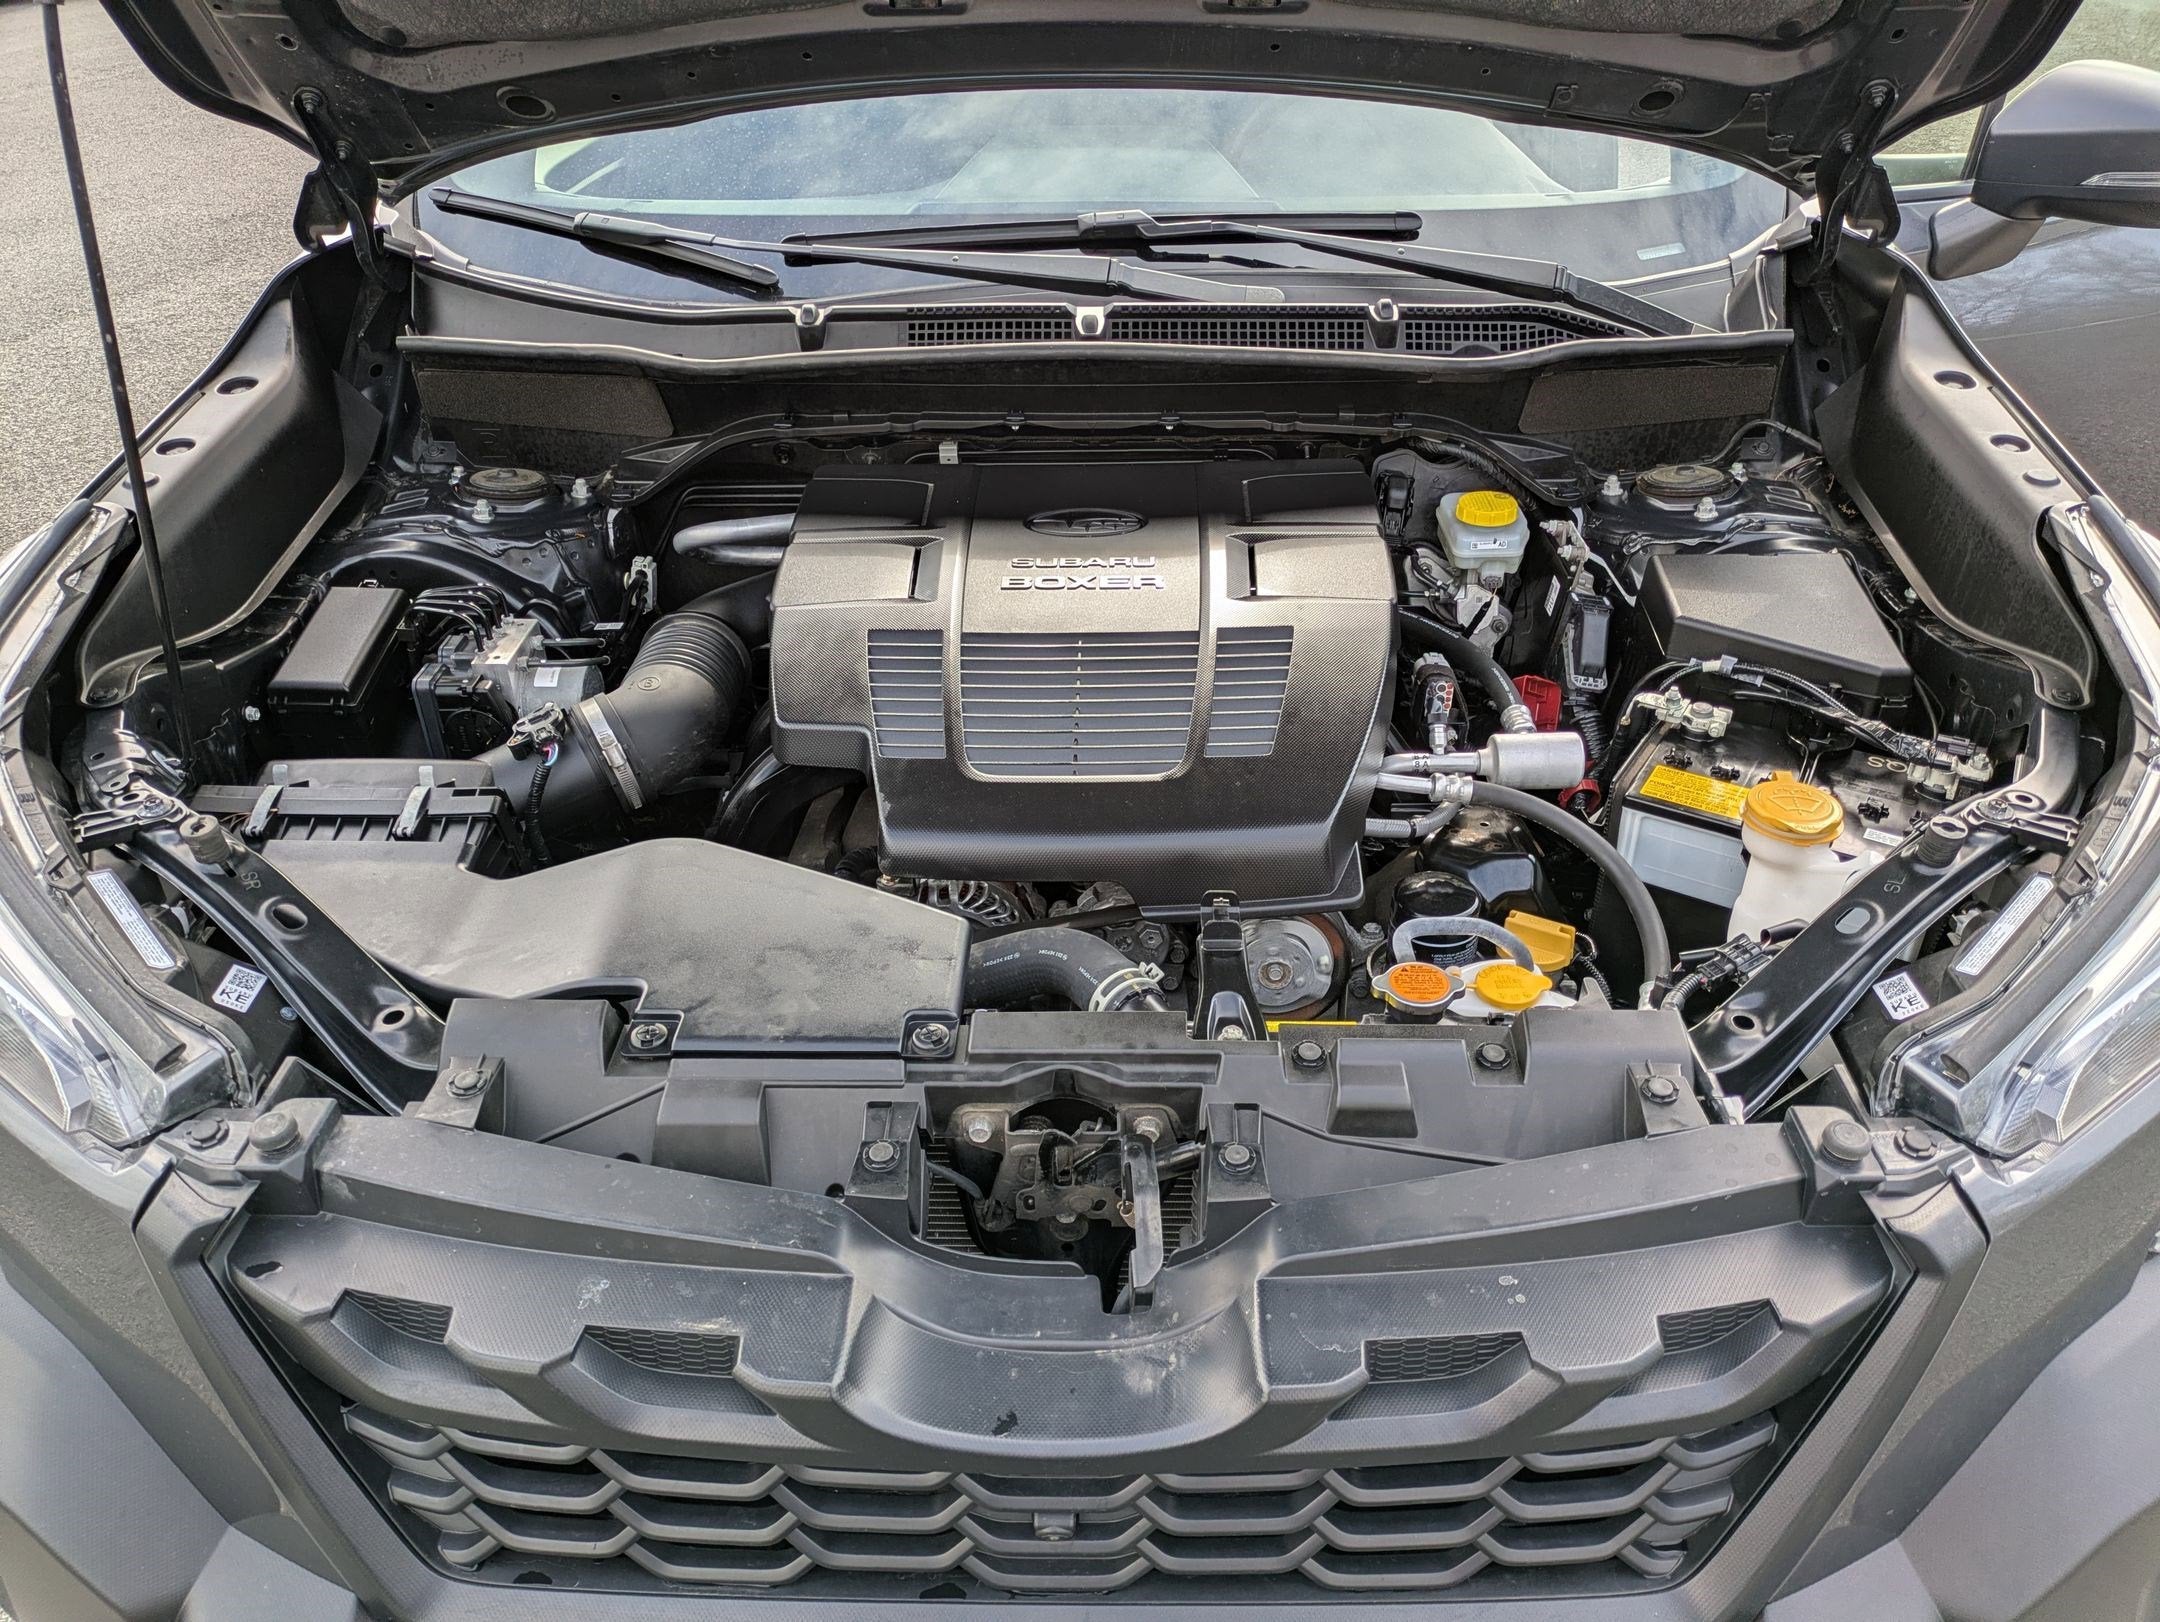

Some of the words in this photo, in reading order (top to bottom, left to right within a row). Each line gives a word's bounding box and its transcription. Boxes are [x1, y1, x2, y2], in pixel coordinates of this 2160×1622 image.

[1011, 556, 1156, 569] SUBARU
[1000, 576, 1165, 591] BOXER
[240, 871, 262, 891] SR
[1883, 873, 1908, 894] SL
[219, 989, 249, 1004] KE
[1891, 995, 1921, 1012] KE
